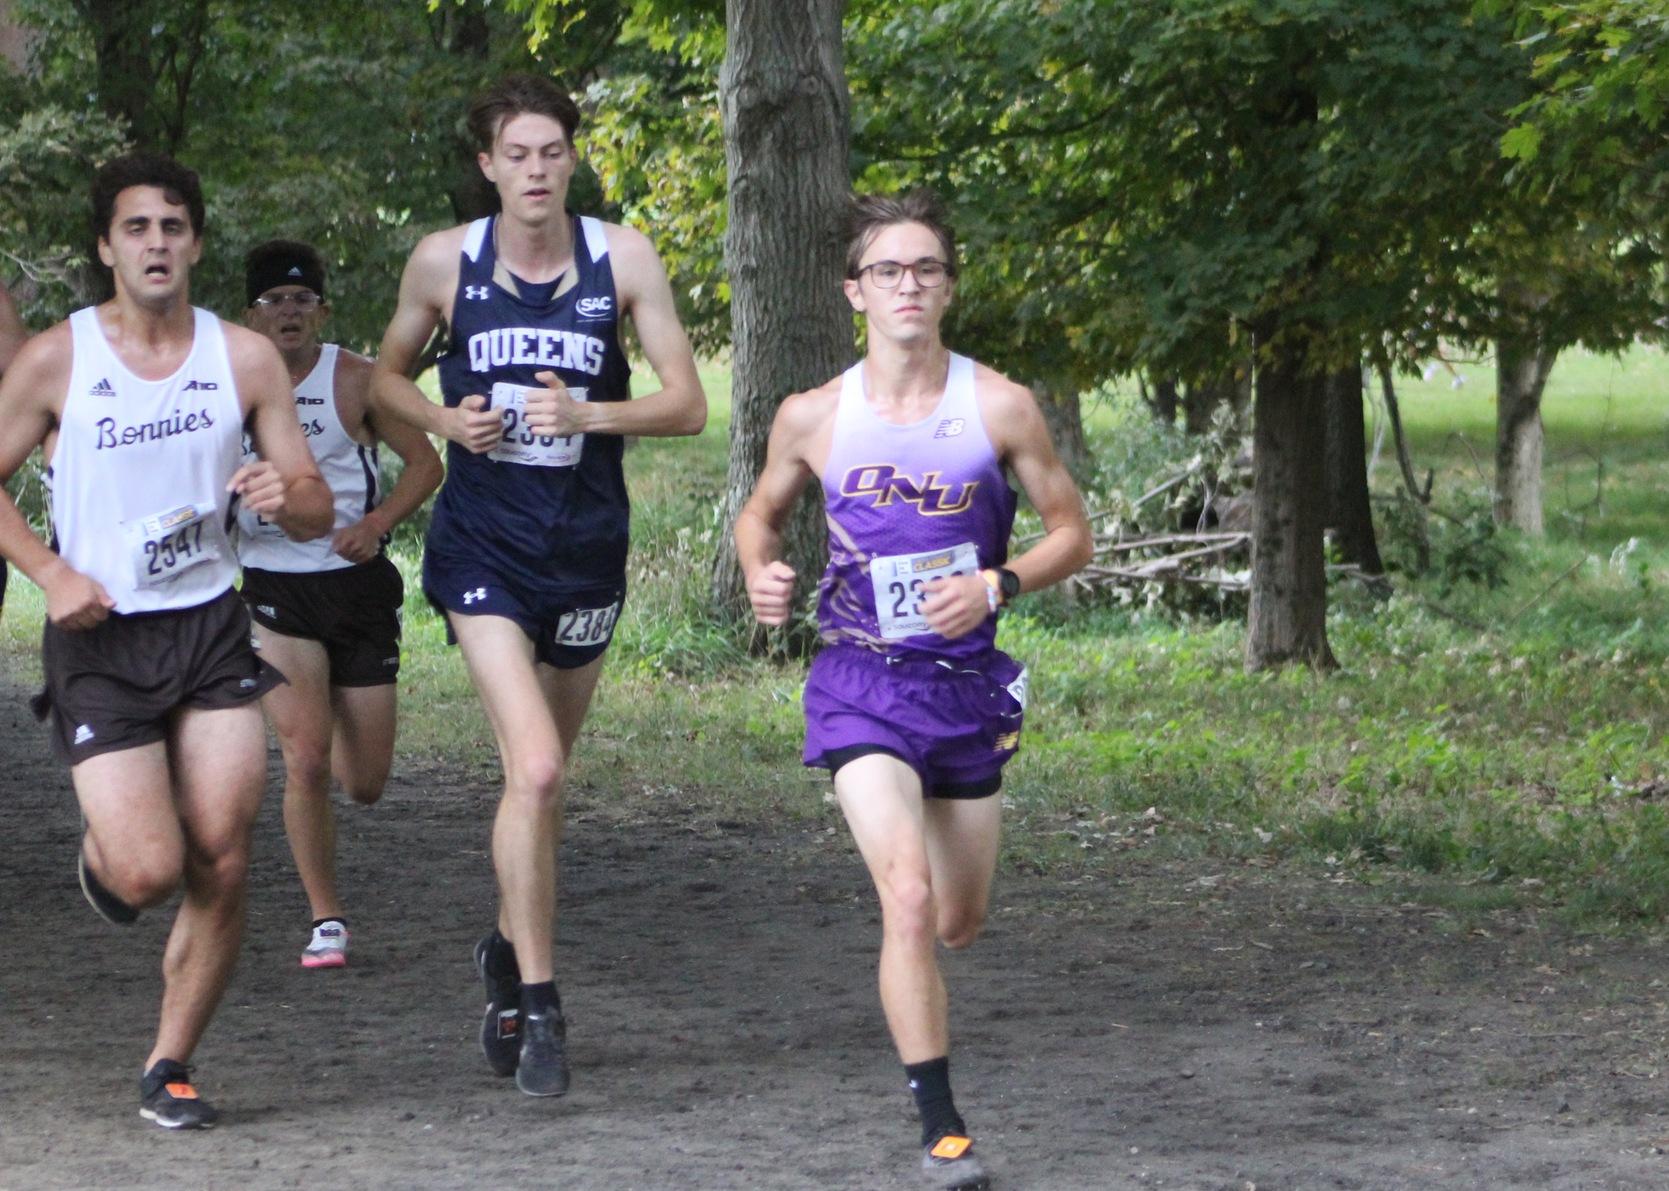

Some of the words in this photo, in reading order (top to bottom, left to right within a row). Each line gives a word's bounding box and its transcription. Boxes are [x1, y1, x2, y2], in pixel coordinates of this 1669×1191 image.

[580, 296, 612, 312] SAC
[468, 327, 605, 376] QUEENS
[95, 408, 215, 450] Bonnies
[840, 463, 980, 517] ONU
[144, 520, 202, 575] 2547
[560, 606, 615, 642] 2384
